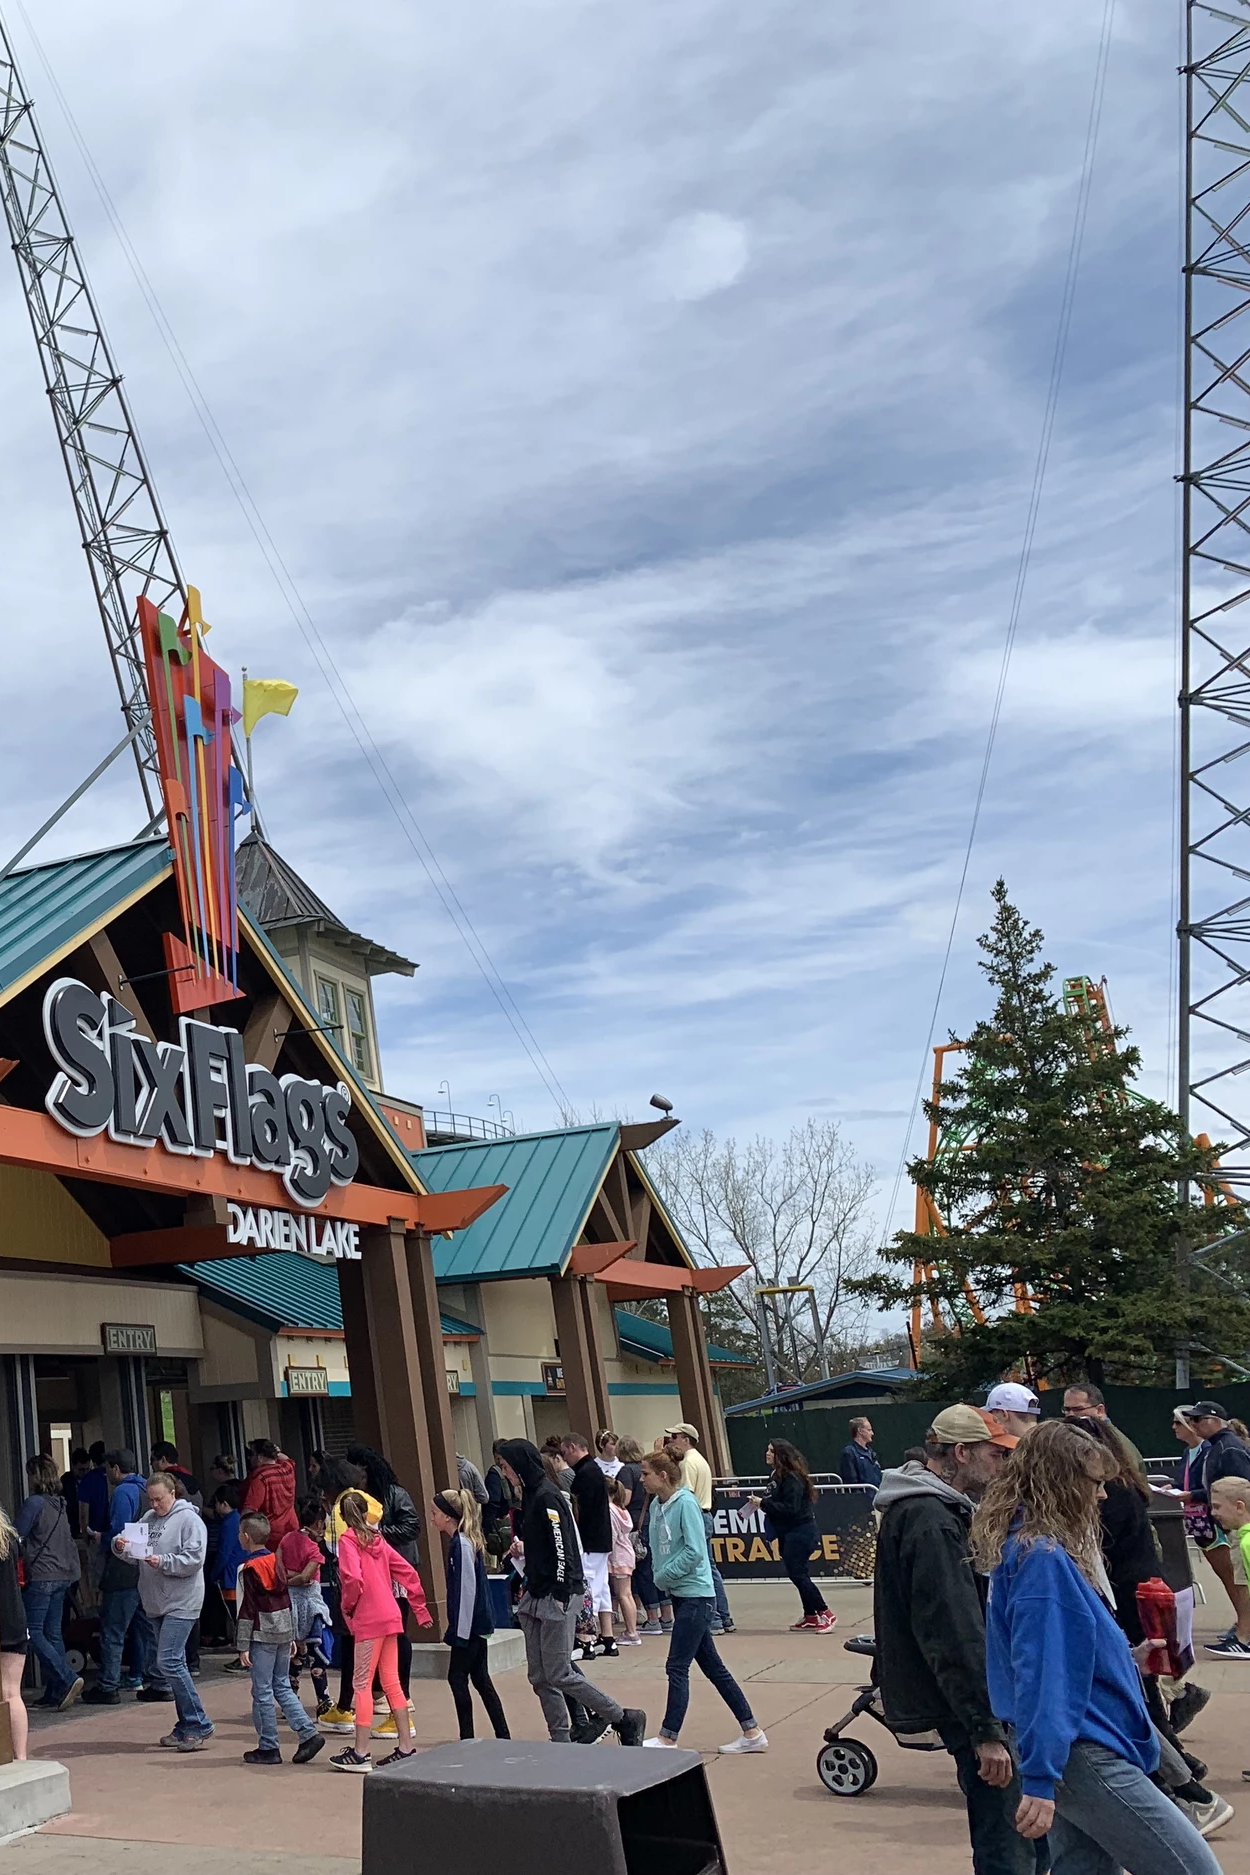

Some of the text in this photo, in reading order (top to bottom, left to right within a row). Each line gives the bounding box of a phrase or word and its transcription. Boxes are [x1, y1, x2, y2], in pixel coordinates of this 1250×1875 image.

[227, 1203, 362, 1259] DARIEN LAKE
[110, 1330, 152, 1349] ENTRY
[291, 1372, 326, 1391] ENTRY
[551, 1519, 565, 1583] AMERICAN EAGLE
